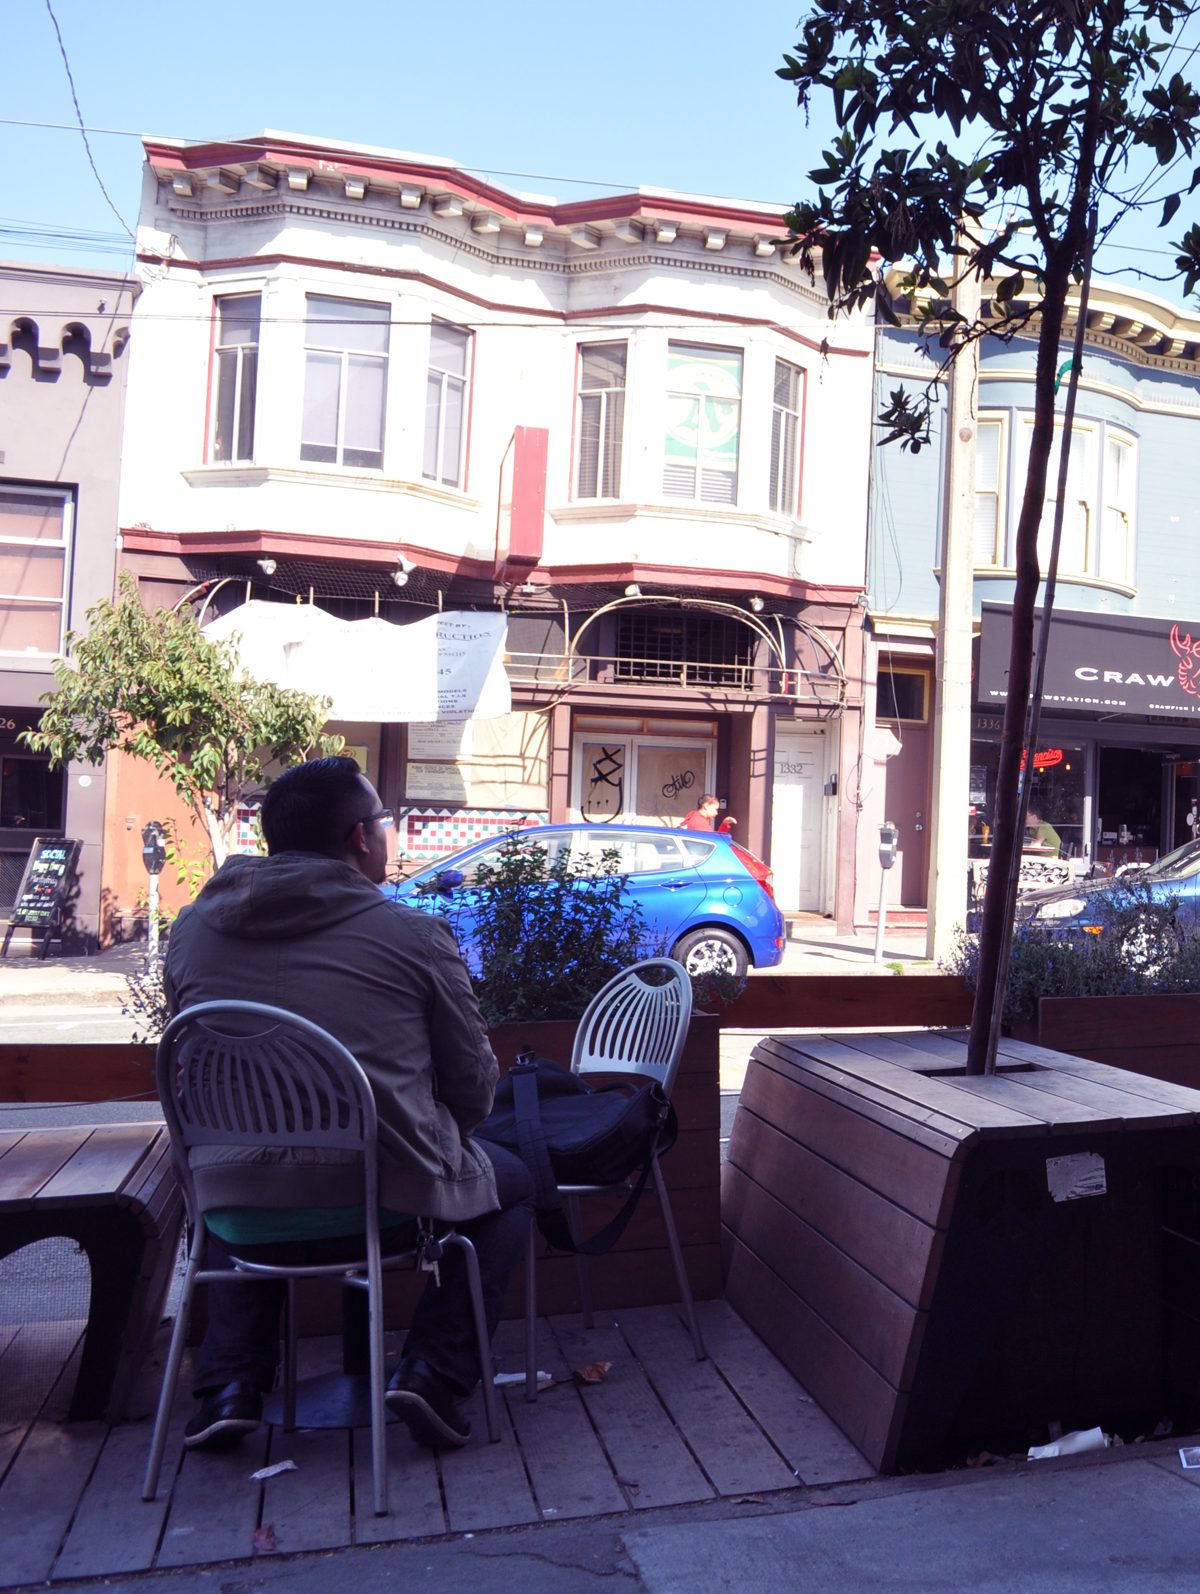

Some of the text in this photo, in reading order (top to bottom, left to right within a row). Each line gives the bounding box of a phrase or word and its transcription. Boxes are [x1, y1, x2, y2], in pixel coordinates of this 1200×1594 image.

[1073, 666, 1175, 687] CRAW
[977, 718, 1000, 730] 1336
[780, 762, 803, 774] 1332
